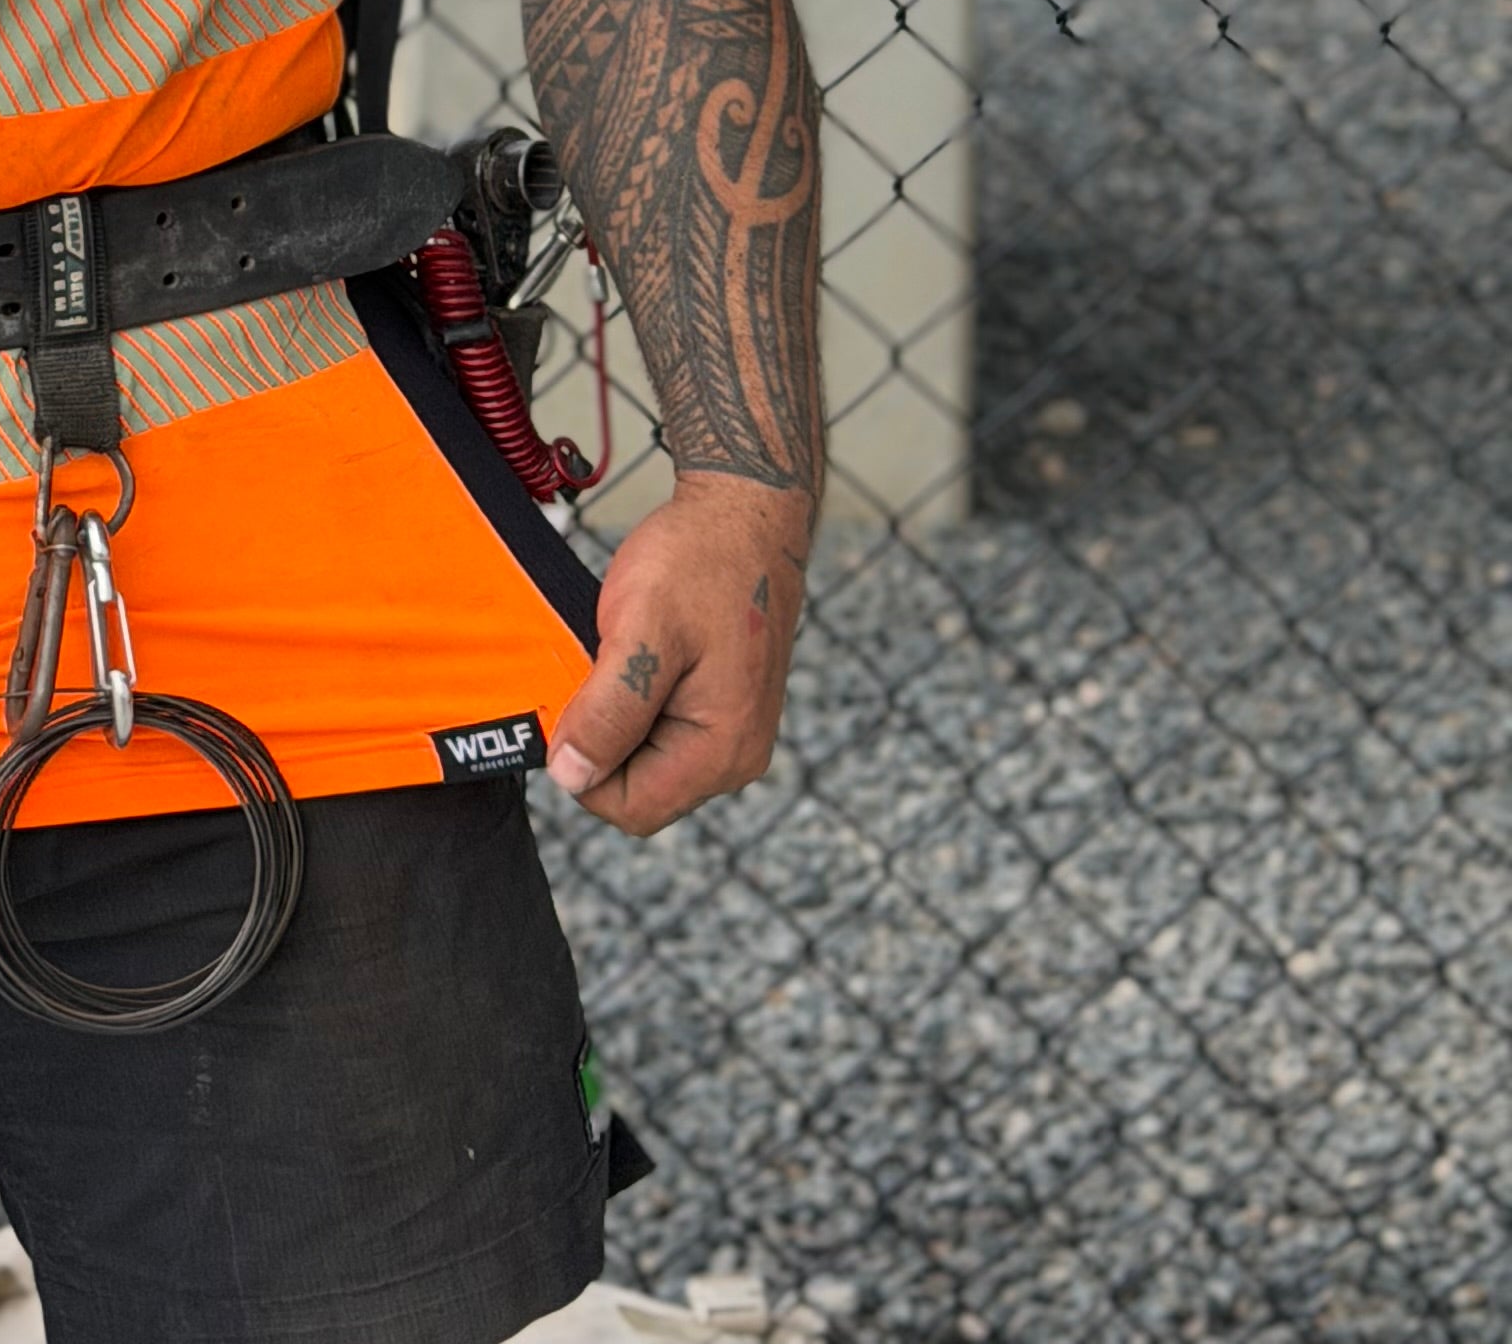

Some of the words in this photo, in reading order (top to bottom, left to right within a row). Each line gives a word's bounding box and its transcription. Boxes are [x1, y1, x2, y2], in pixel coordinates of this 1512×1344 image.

[66, 201, 82, 252] STRAP
[48, 203, 67, 312] SYSTEM
[444, 722, 533, 764] WOLF
